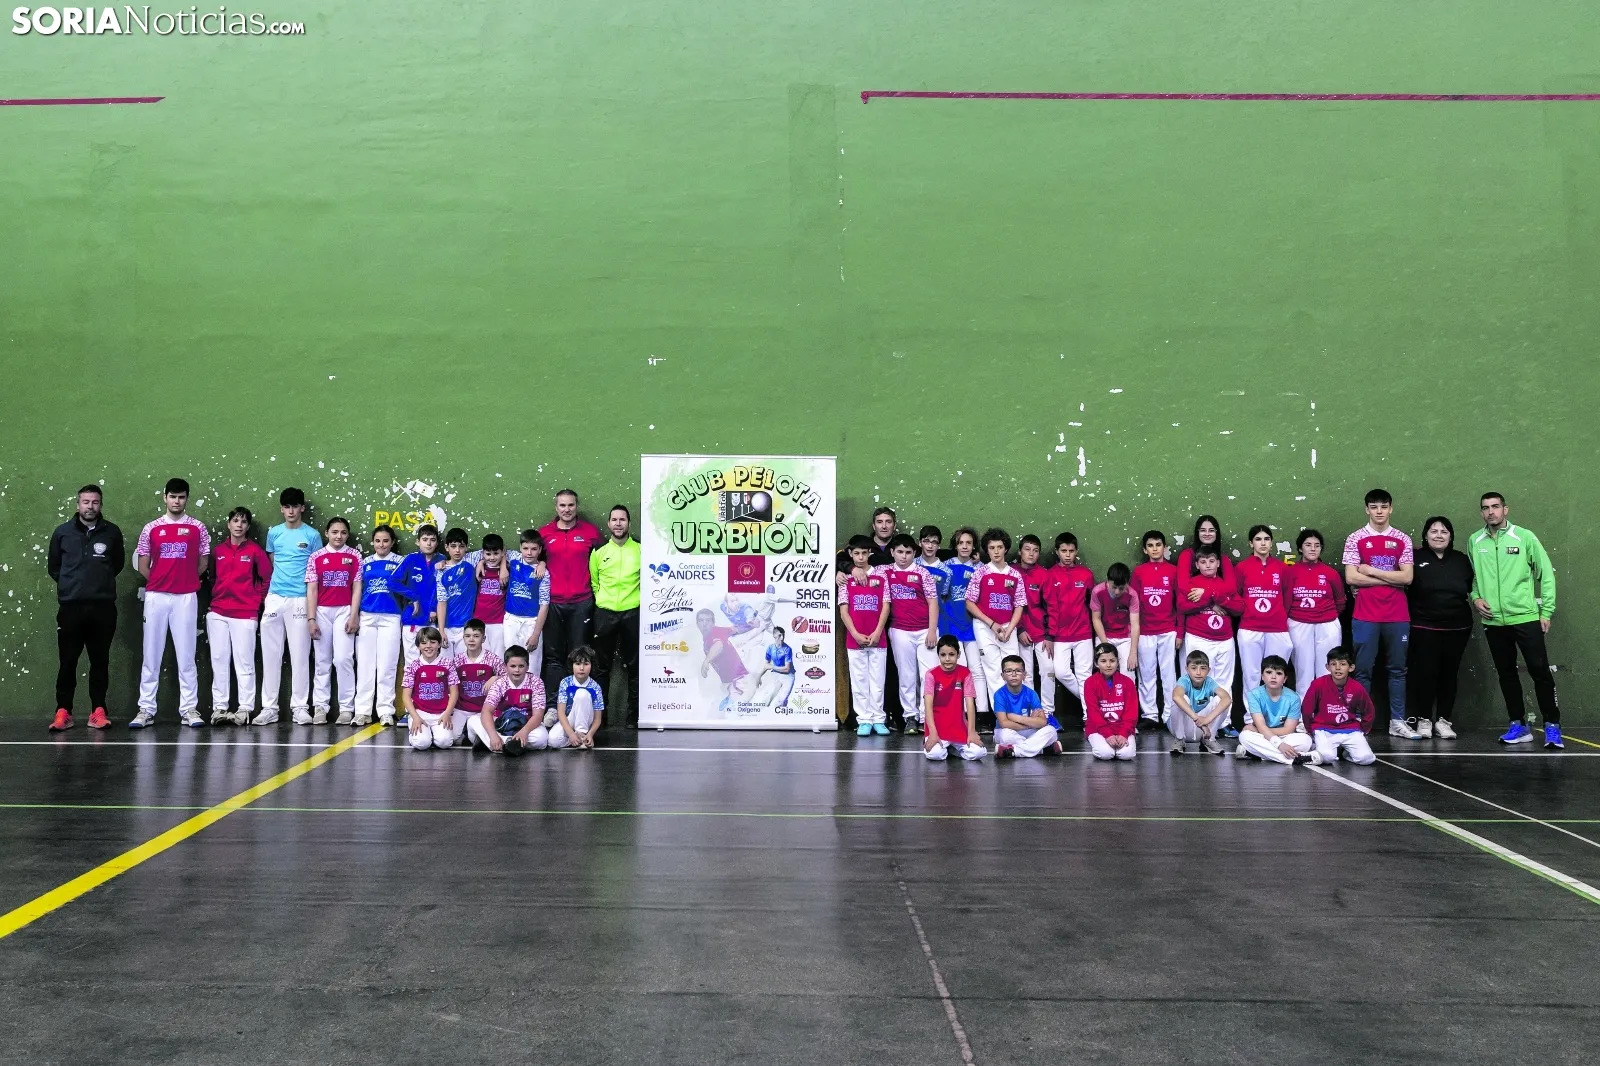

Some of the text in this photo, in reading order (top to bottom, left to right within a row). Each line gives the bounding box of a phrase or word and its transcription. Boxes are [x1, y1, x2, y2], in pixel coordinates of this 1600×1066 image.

[667, 465, 822, 516] CLUB PELOTA
[374, 510, 437, 531] PASA
[671, 513, 820, 554] URBIÓN
[668, 570, 715, 580] ANDRES
[770, 562, 829, 583] Real
[652, 585, 687, 598] Arte
[797, 589, 829, 600] SAGA
[649, 598, 693, 612] Fritas
[809, 625, 831, 633] HACHA
[647, 702, 692, 711] #eligeSoria
[775, 707, 793, 715] Caja
